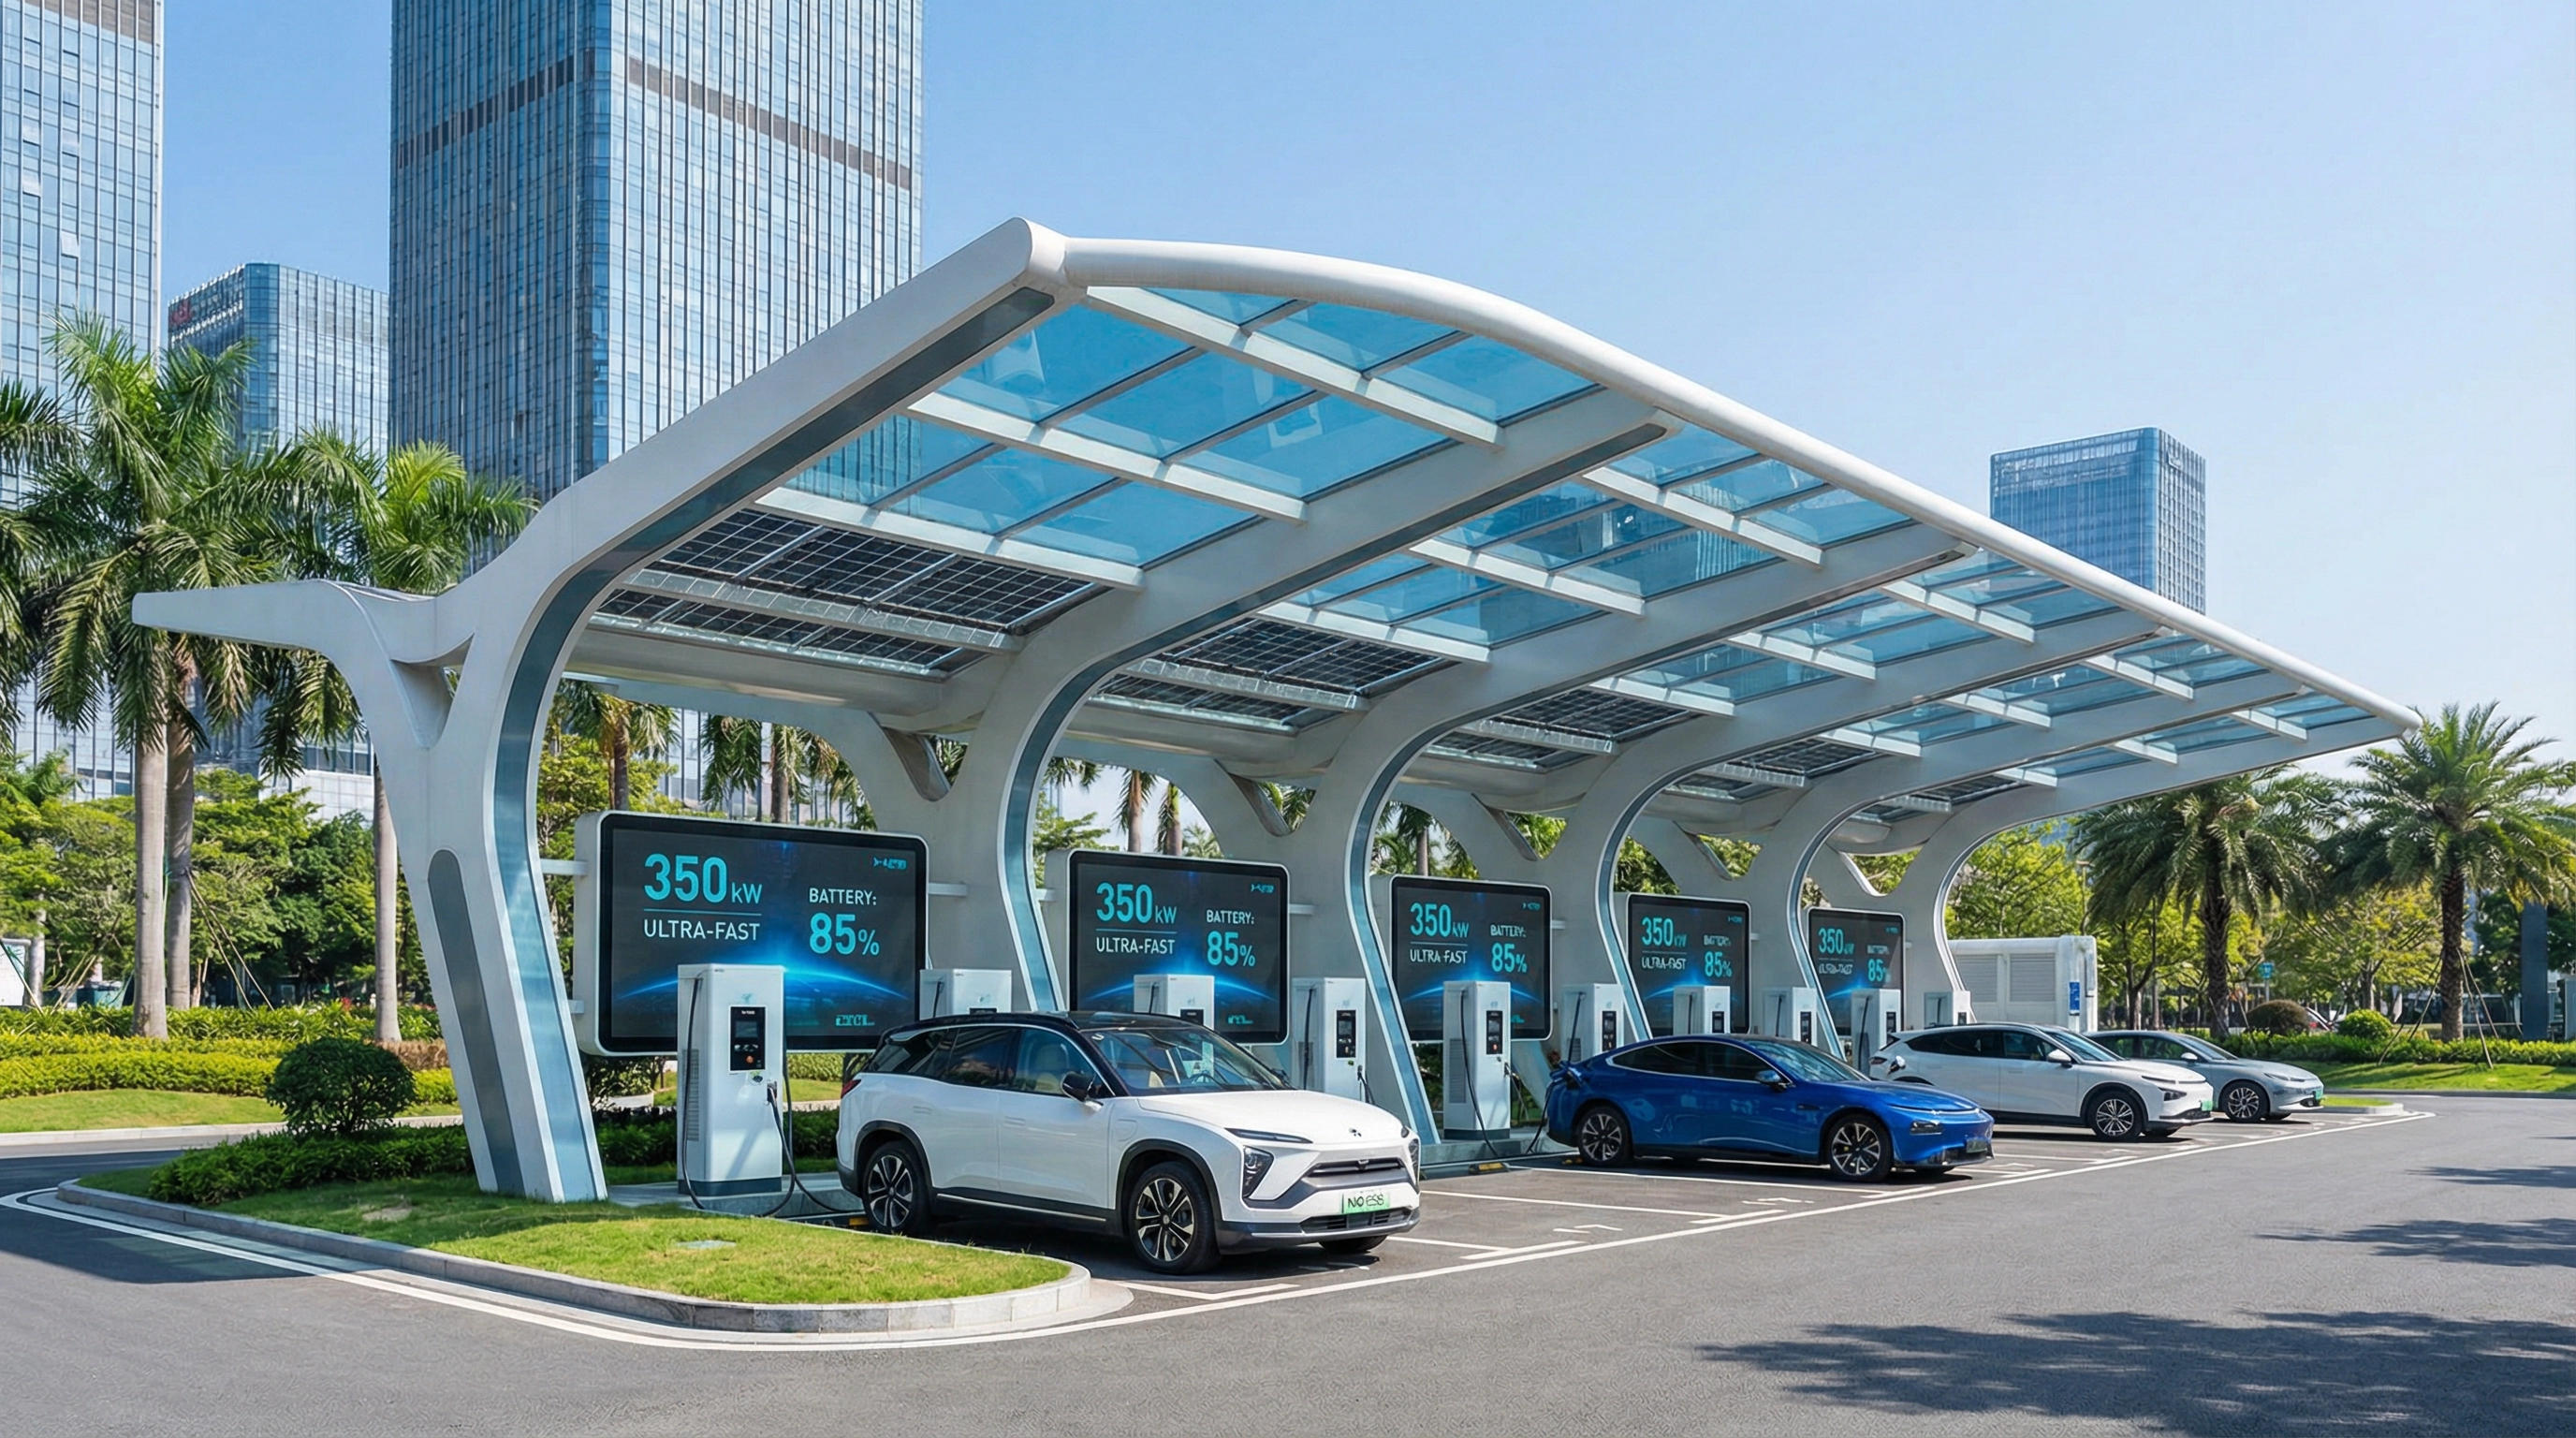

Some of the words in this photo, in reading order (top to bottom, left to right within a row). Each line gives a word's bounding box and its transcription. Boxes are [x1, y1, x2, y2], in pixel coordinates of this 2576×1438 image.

[645, 854, 726, 902] 350
[732, 883, 762, 903] kW
[810, 888, 876, 905] BATTERY:
[1097, 883, 1152, 923] 350
[1156, 905, 1177, 923] kW
[644, 919, 760, 941] ULTRA-FAST
[1207, 910, 1253, 924] BATTERY:
[1411, 902, 1451, 936] 350
[1642, 917, 1673, 946] 350
[810, 913, 879, 955] 85%
[1096, 937, 1175, 954] ULTRA-FAST
[1208, 932, 1255, 966] 85%
[1492, 942, 1528, 972] 85%
